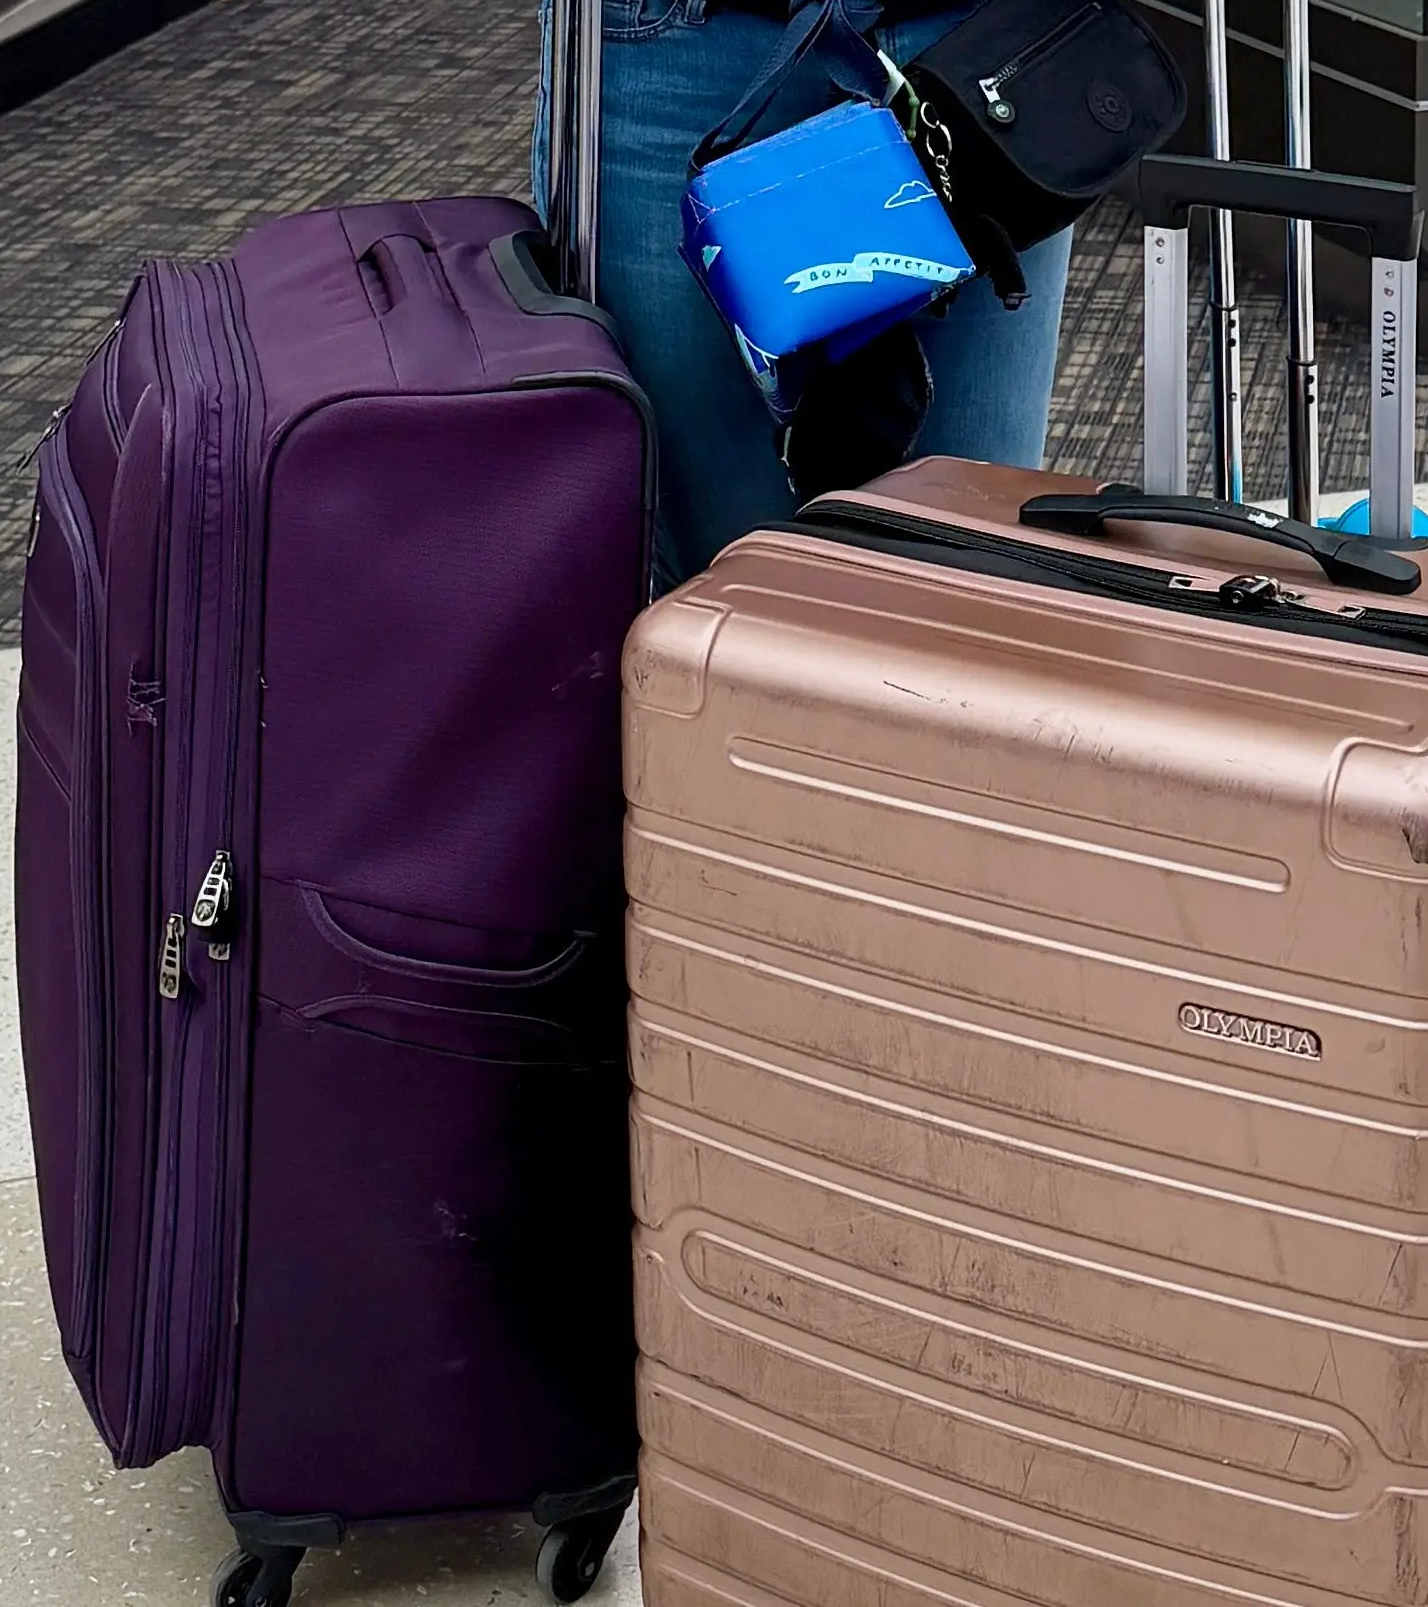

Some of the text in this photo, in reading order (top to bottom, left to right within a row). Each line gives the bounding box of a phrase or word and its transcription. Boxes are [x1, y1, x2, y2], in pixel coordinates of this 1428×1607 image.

[808, 254, 945, 282] BON APPETIT
[1380, 309, 1398, 399] OLYMPIA
[1179, 1004, 1320, 1058] OLYMPIA
